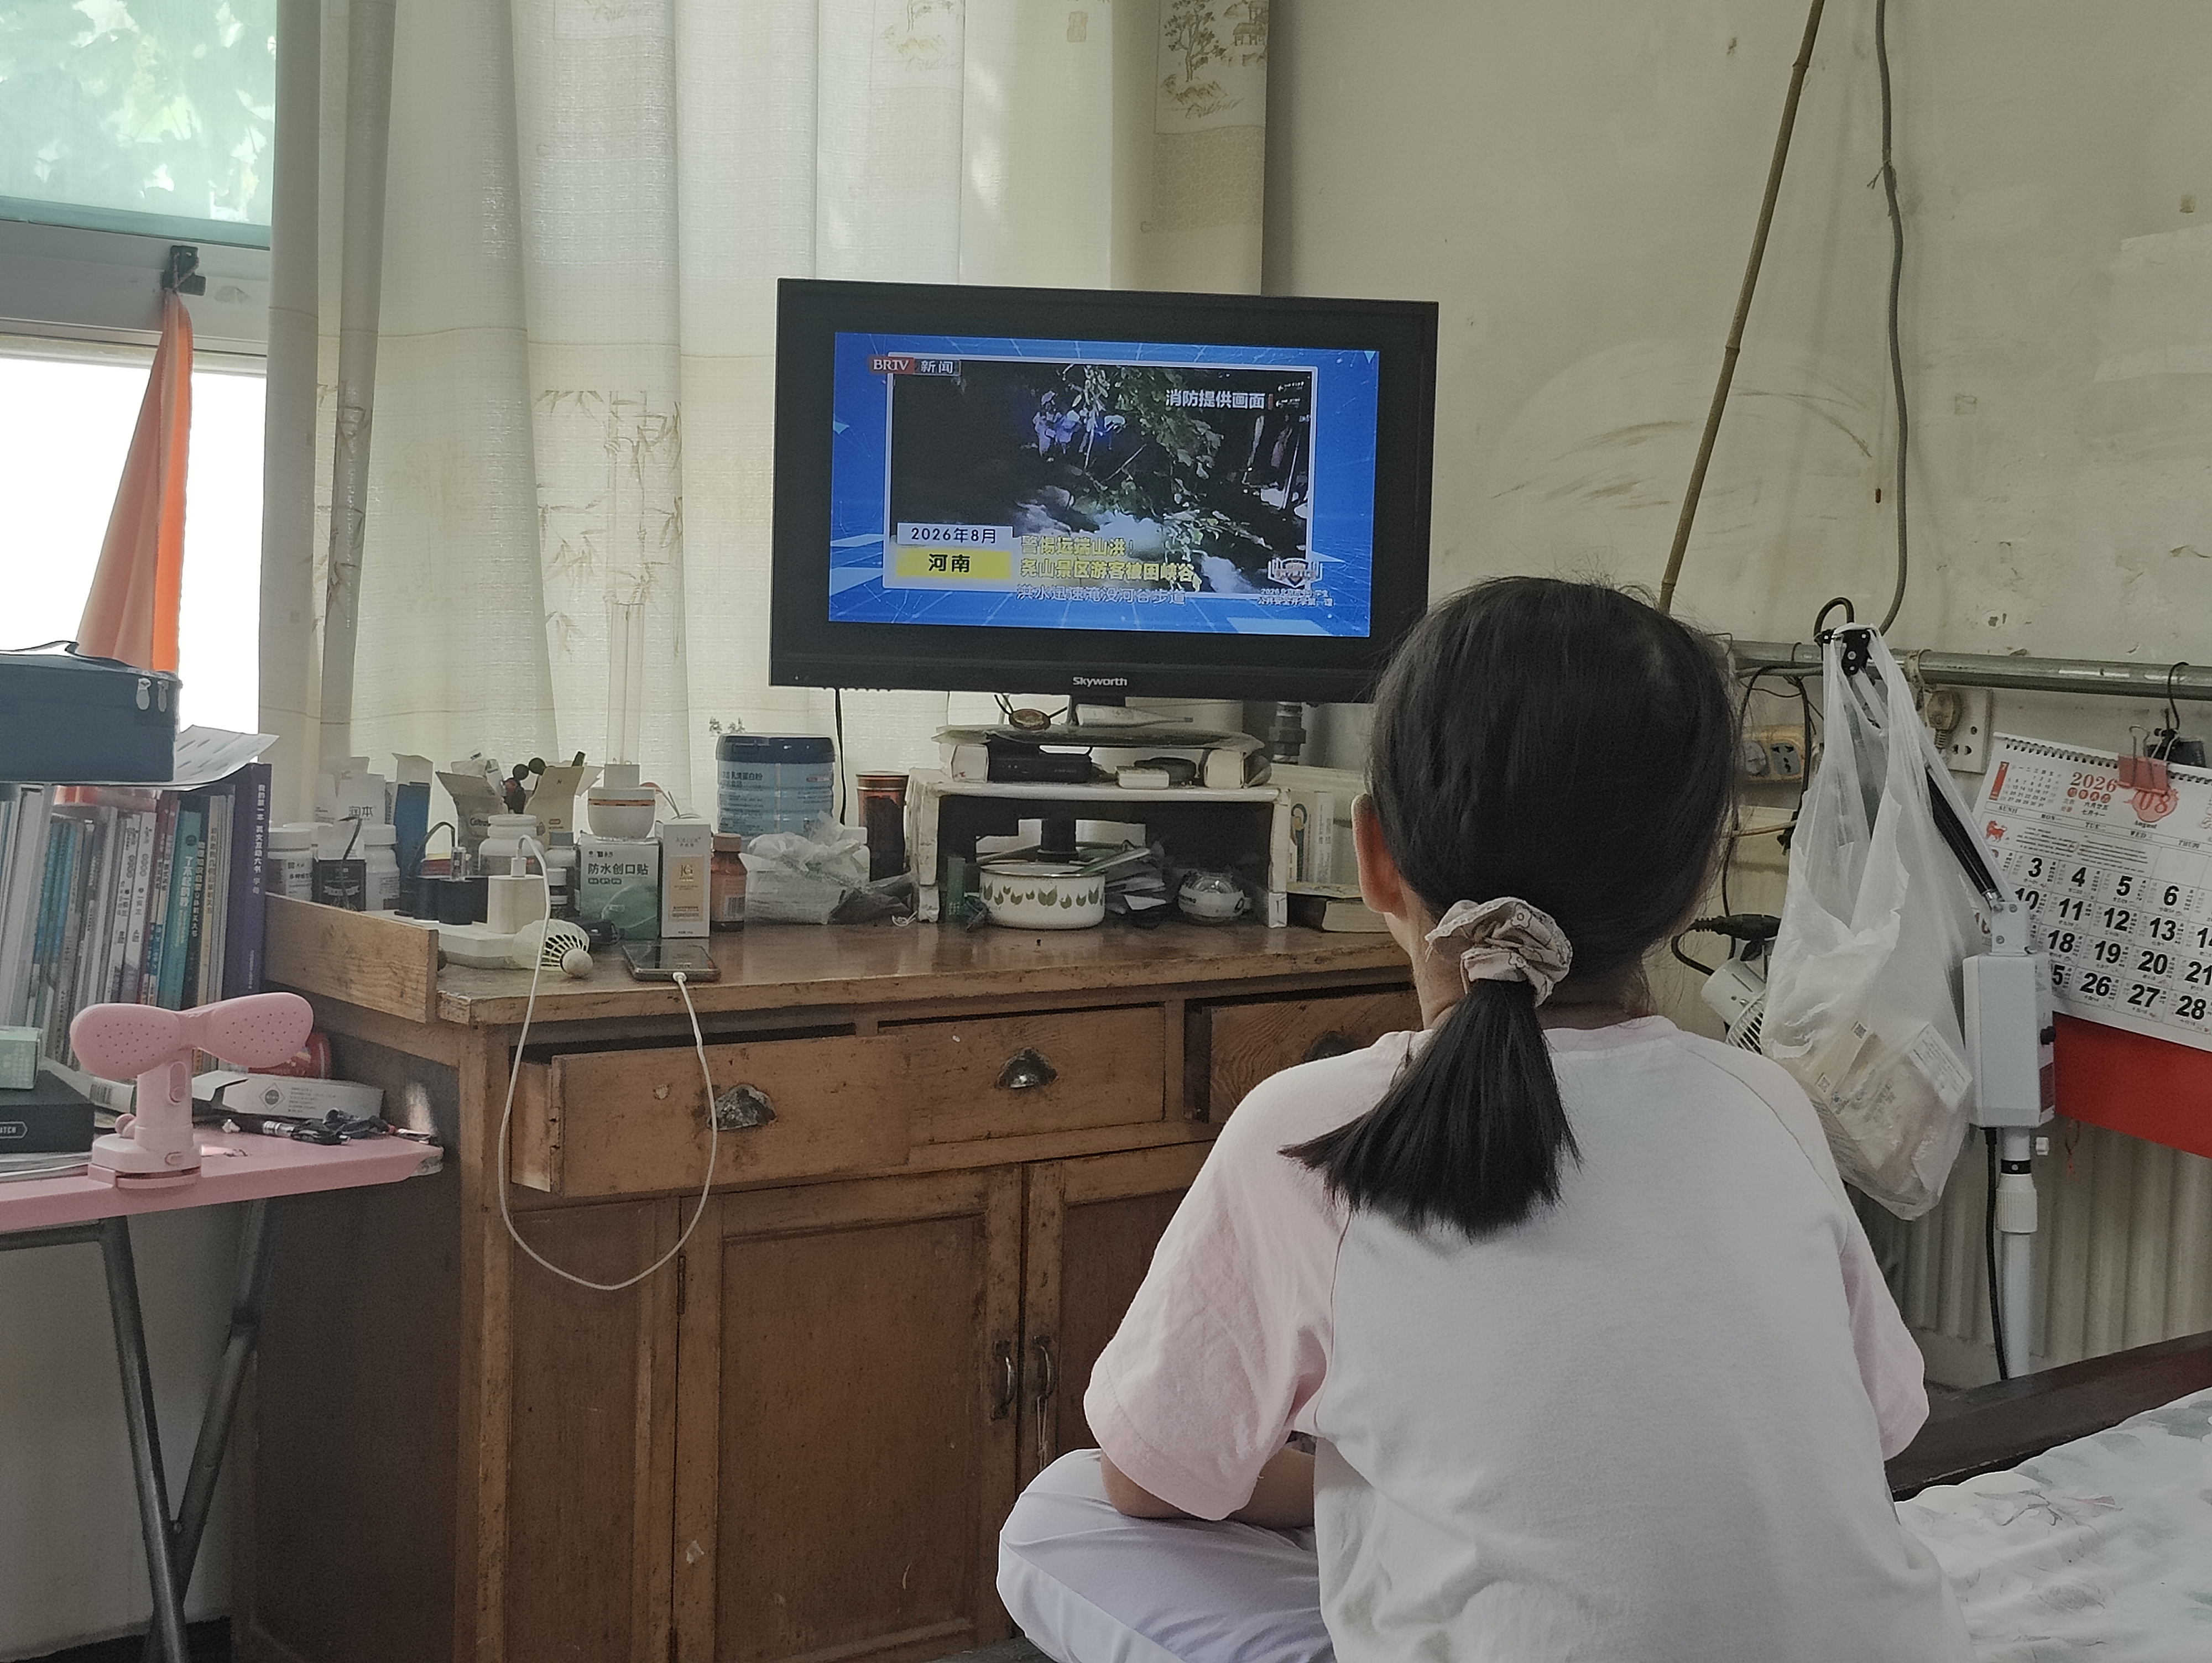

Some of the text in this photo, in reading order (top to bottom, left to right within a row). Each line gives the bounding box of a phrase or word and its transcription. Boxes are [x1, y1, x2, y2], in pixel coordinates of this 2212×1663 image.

[873, 359, 954, 374] BRTV 新闻
[1165, 389, 1266, 409] 消防提供画面
[911, 527, 996, 543] 2026年8月
[928, 553, 971, 573] 河南
[1020, 558, 1194, 582] 尧山景区游客被困峡谷
[1073, 677, 1128, 687] Skyworth
[2070, 772, 2118, 792] 2026
[349, 806, 373, 818] 润本
[2139, 791, 2171, 813] 08
[587, 863, 649, 875] 防水创口贴
[2028, 857, 2180, 906] 3 4 5 6
[2058, 898, 2084, 921] 11
[2104, 907, 2130, 932] 12
[2150, 917, 2176, 941] 13
[2048, 929, 2075, 953] 18
[2094, 940, 2121, 964] 19
[2137, 950, 2168, 975] 20
[2184, 961, 2212, 986] 21
[2052, 964, 2206, 1020] 5 26 27 28
